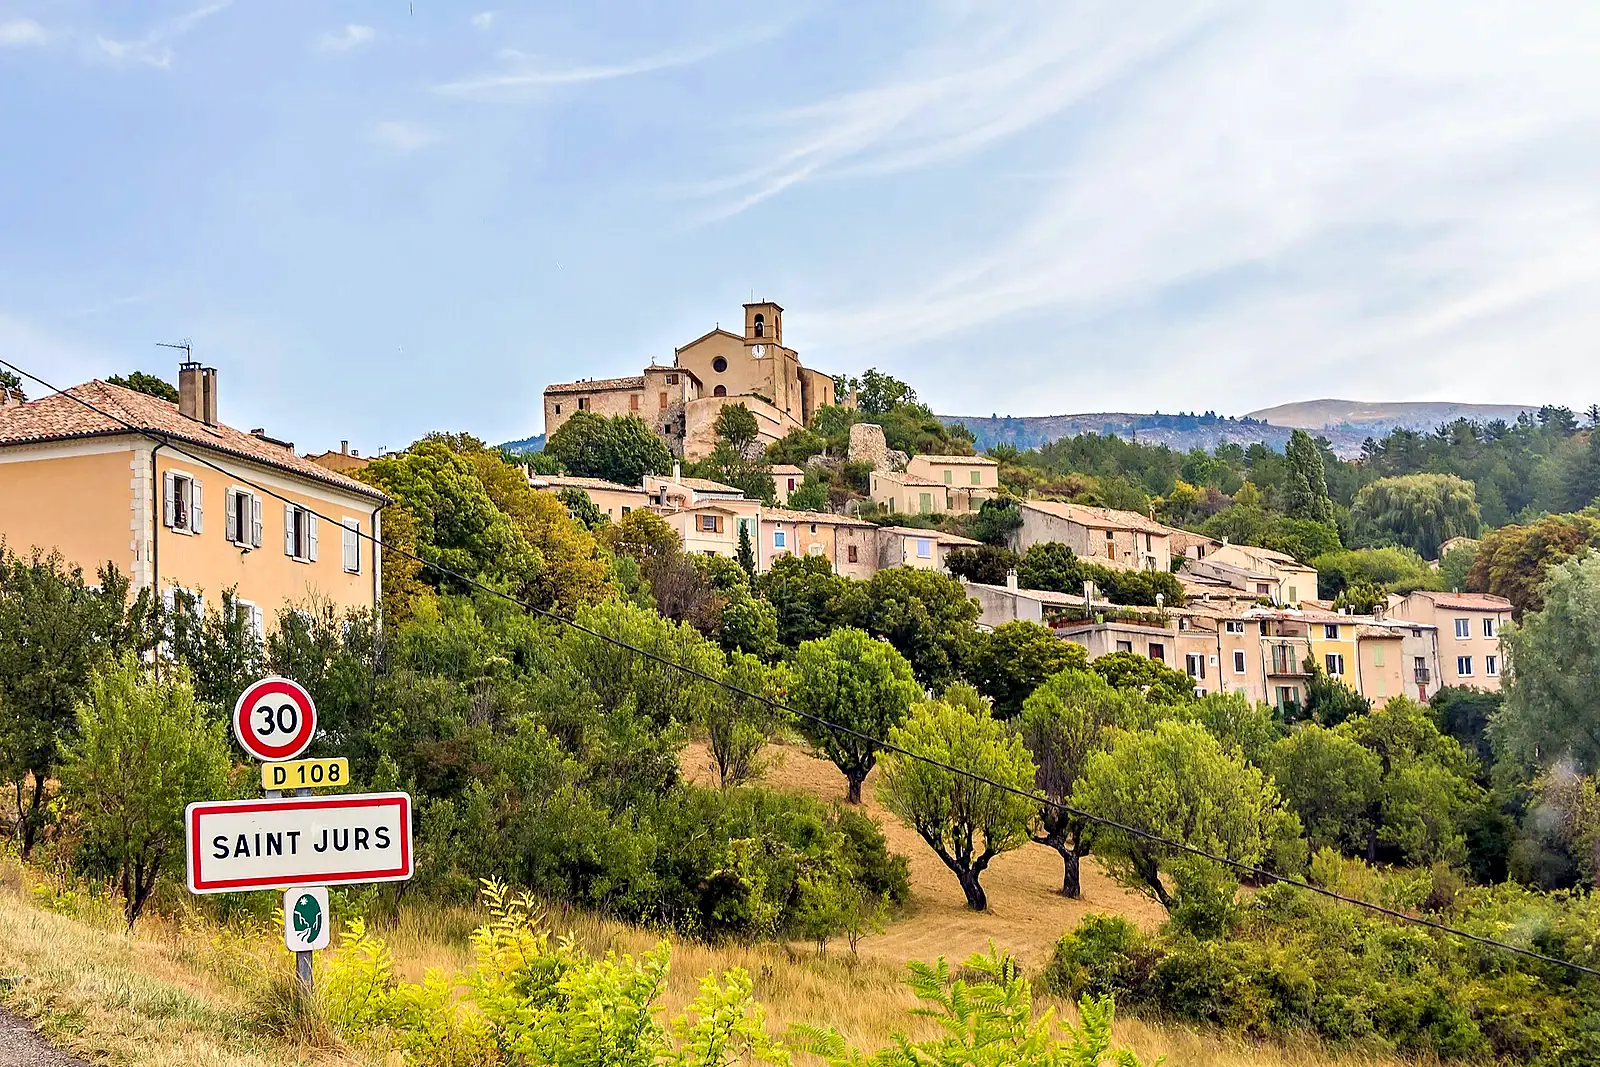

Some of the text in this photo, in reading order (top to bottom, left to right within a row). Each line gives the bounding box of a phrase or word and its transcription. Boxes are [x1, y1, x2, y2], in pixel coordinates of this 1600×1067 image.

[256, 704, 297, 736] 30
[274, 764, 341, 785] D 108
[212, 826, 391, 859] SAINT JURS
